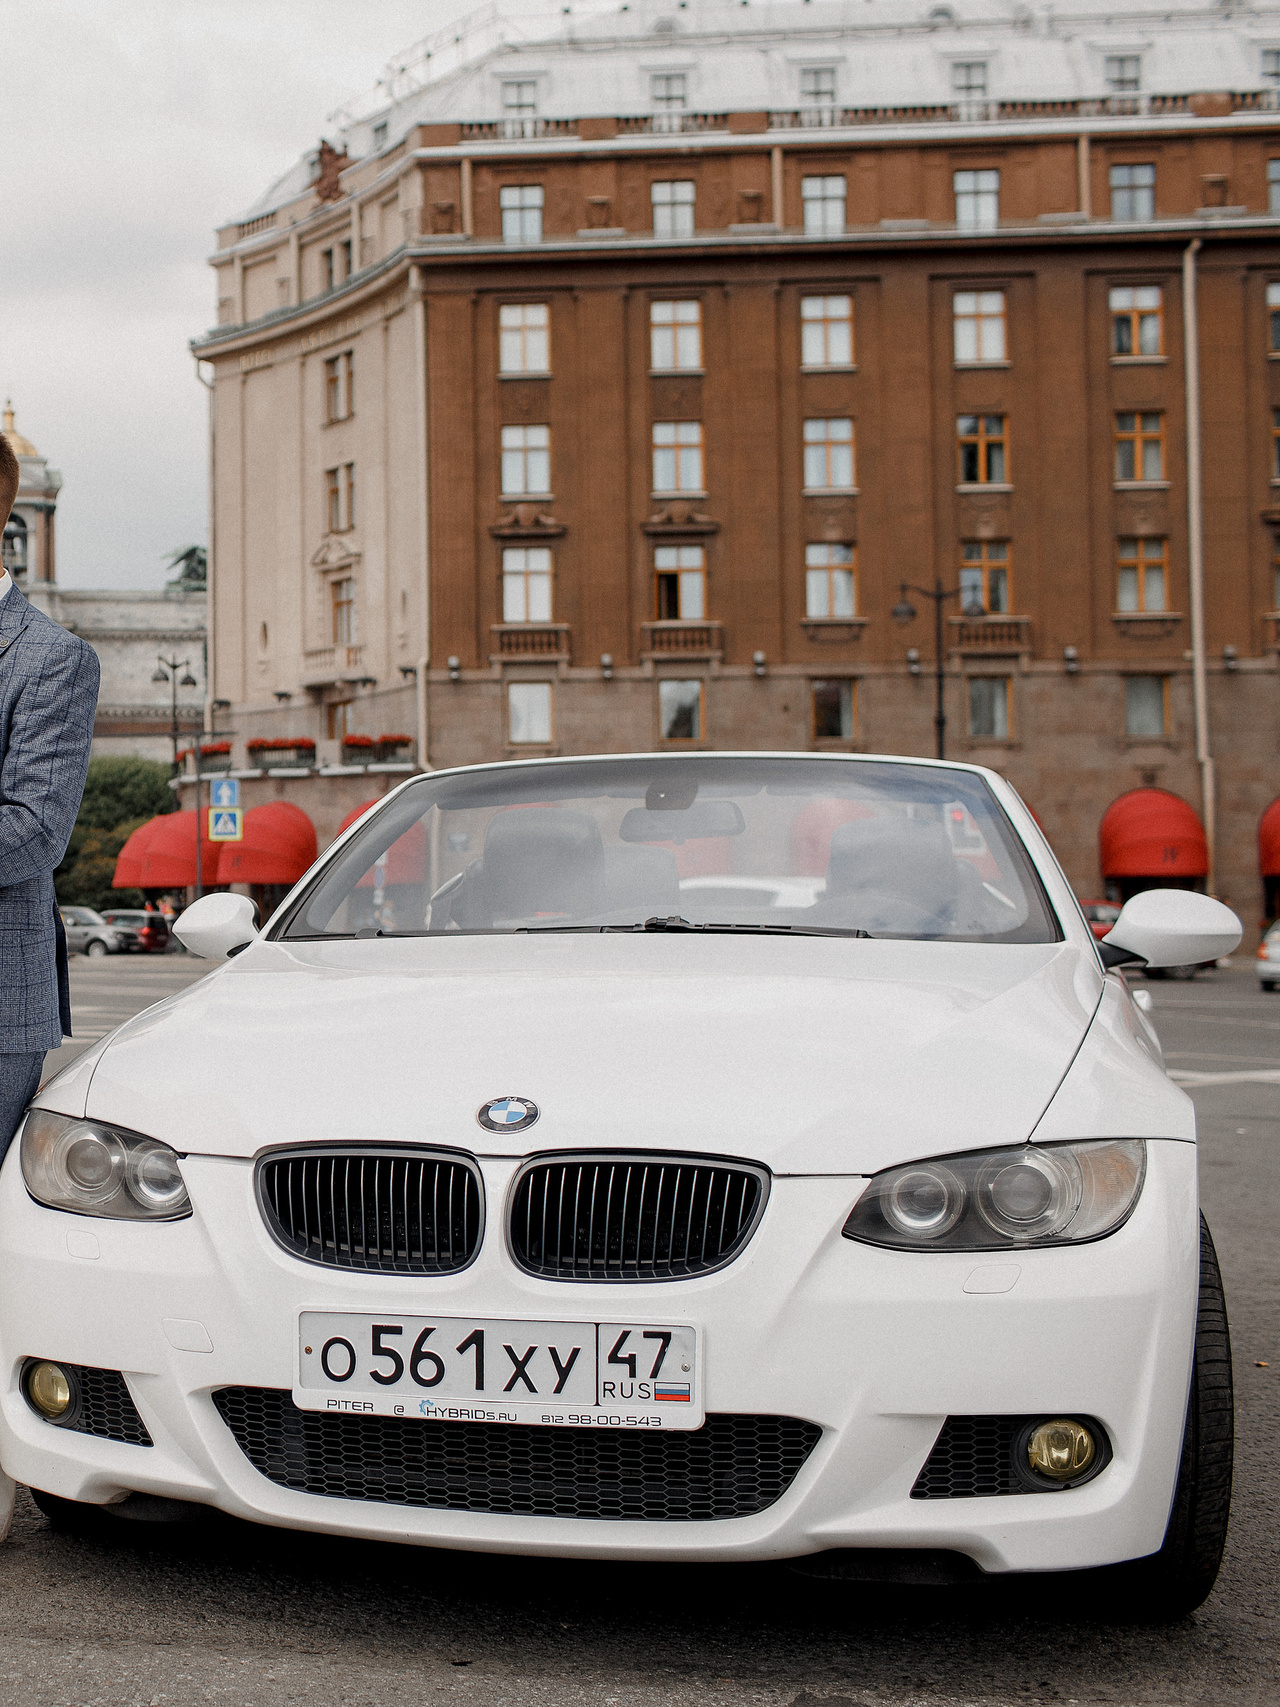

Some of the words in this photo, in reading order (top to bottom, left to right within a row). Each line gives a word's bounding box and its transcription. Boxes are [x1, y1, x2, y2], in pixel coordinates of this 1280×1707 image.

[607, 1329, 672, 1379] 47
[602, 1381, 651, 1399] RUS
[327, 1399, 374, 1412] PITER
[541, 1414, 564, 1424] 812
[568, 1414, 662, 1427] 98-00-543
